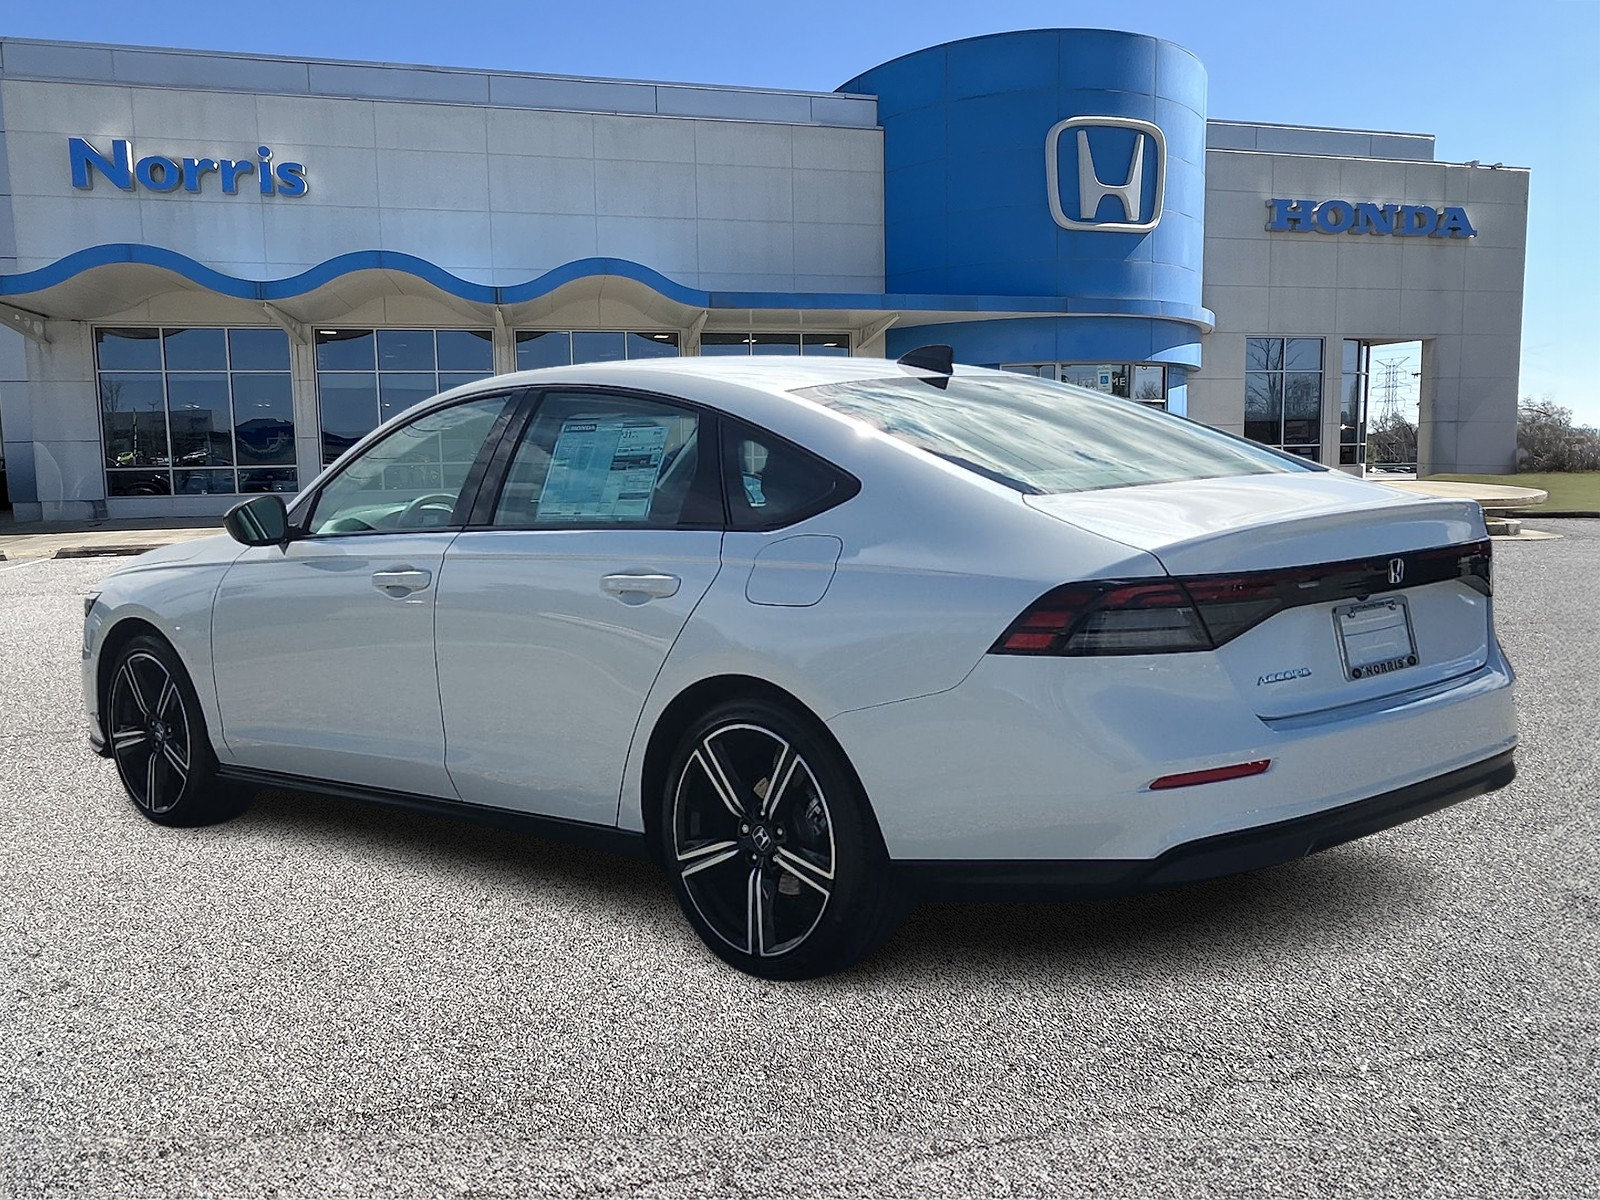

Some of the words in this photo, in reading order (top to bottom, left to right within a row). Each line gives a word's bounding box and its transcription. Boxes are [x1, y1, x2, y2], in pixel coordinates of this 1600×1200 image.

[68, 137, 309, 197] Norris
[1266, 198, 1478, 238] HONDA
[1257, 667, 1312, 686] ACCORD
[1365, 659, 1404, 676] NORRIS
